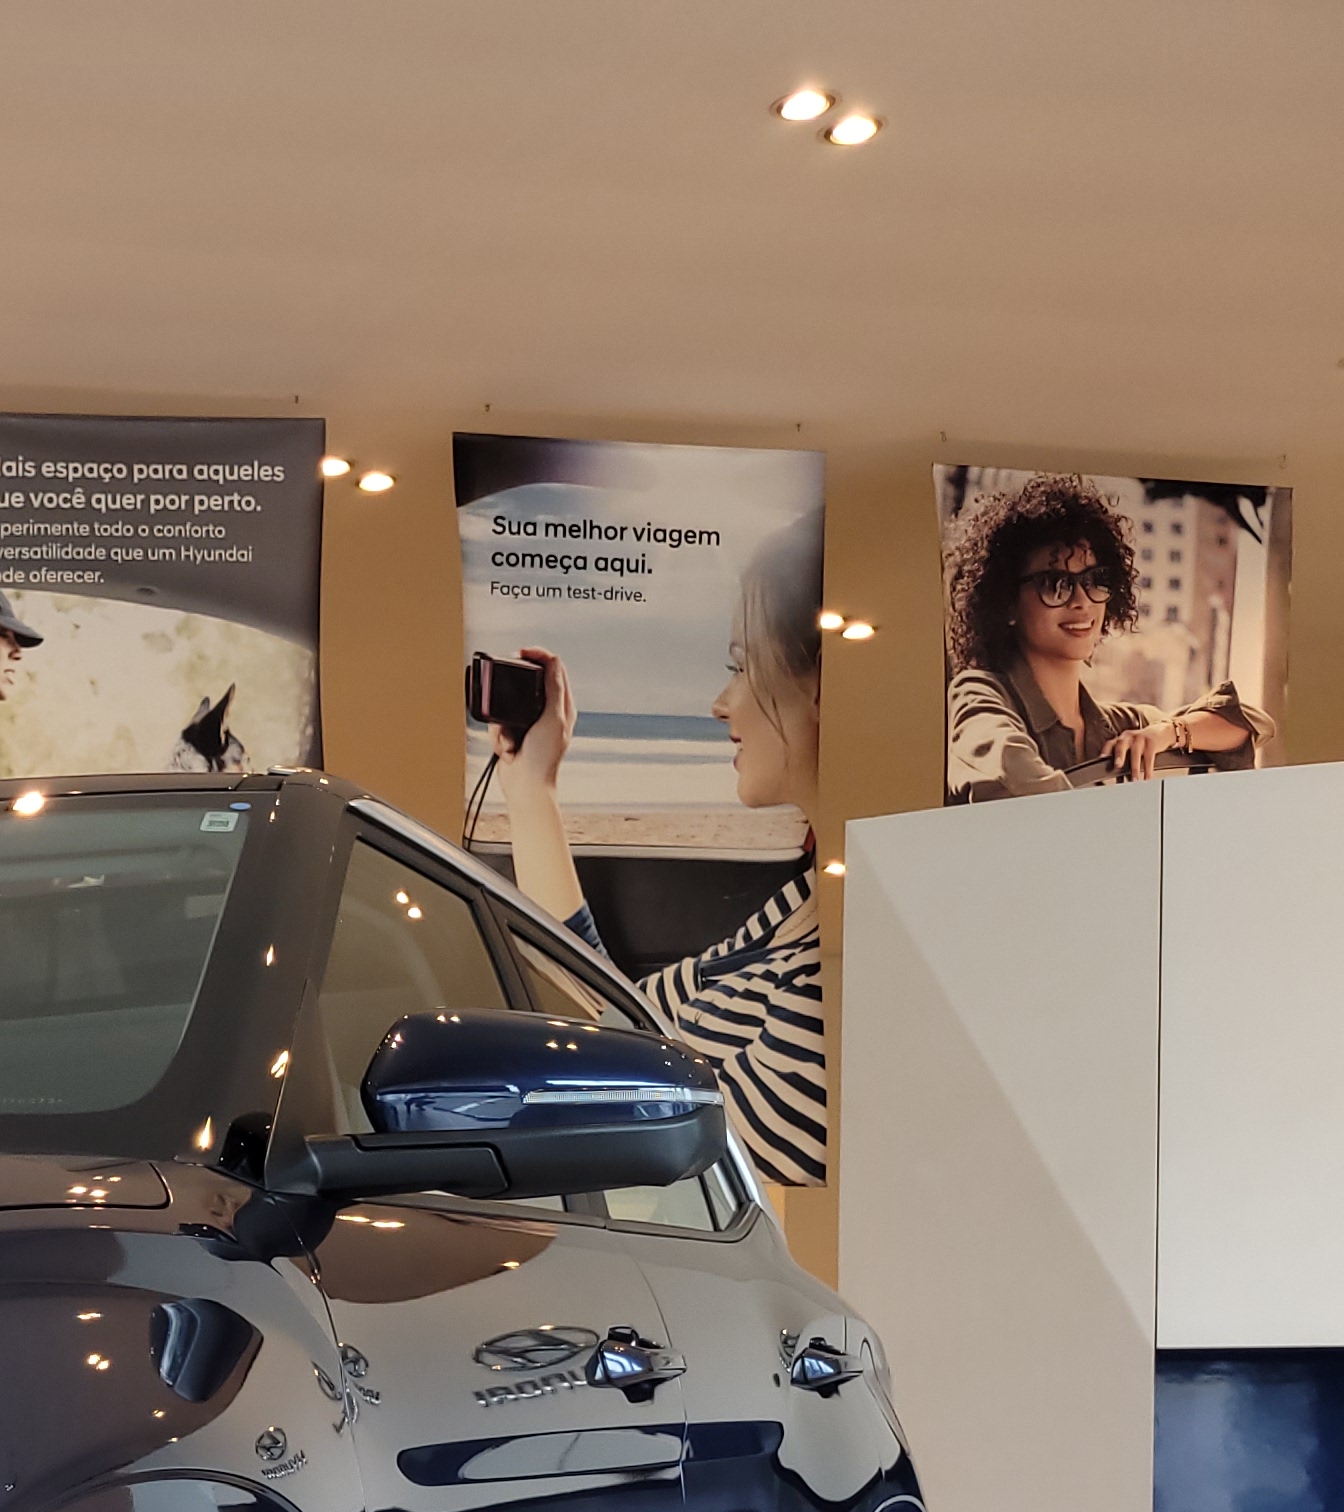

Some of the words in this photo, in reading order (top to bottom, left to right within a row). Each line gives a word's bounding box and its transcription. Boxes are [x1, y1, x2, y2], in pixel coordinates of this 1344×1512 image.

[40, 461, 127, 482] espaço
[132, 463, 188, 483] para
[193, 460, 286, 484] aqueles
[29, 487, 86, 509] você
[90, 492, 145, 513] quer
[149, 493, 189, 514] por
[194, 492, 262, 514] perto.
[93, 521, 134, 537] todo
[137, 525, 149, 537] o
[153, 521, 226, 539] conforto
[491, 515, 538, 537] Sua
[544, 519, 629, 542] melhor
[632, 522, 720, 548] viagem
[110, 549, 144, 563] que
[147, 549, 176, 561] um
[180, 545, 253, 564] Hyundai
[490, 551, 588, 574] começa
[594, 553, 653, 577] aqui.
[29, 568, 105, 584] oferecer.
[490, 581, 531, 599] Faça
[535, 585, 562, 598] um
[567, 585, 647, 602] test-drive.
